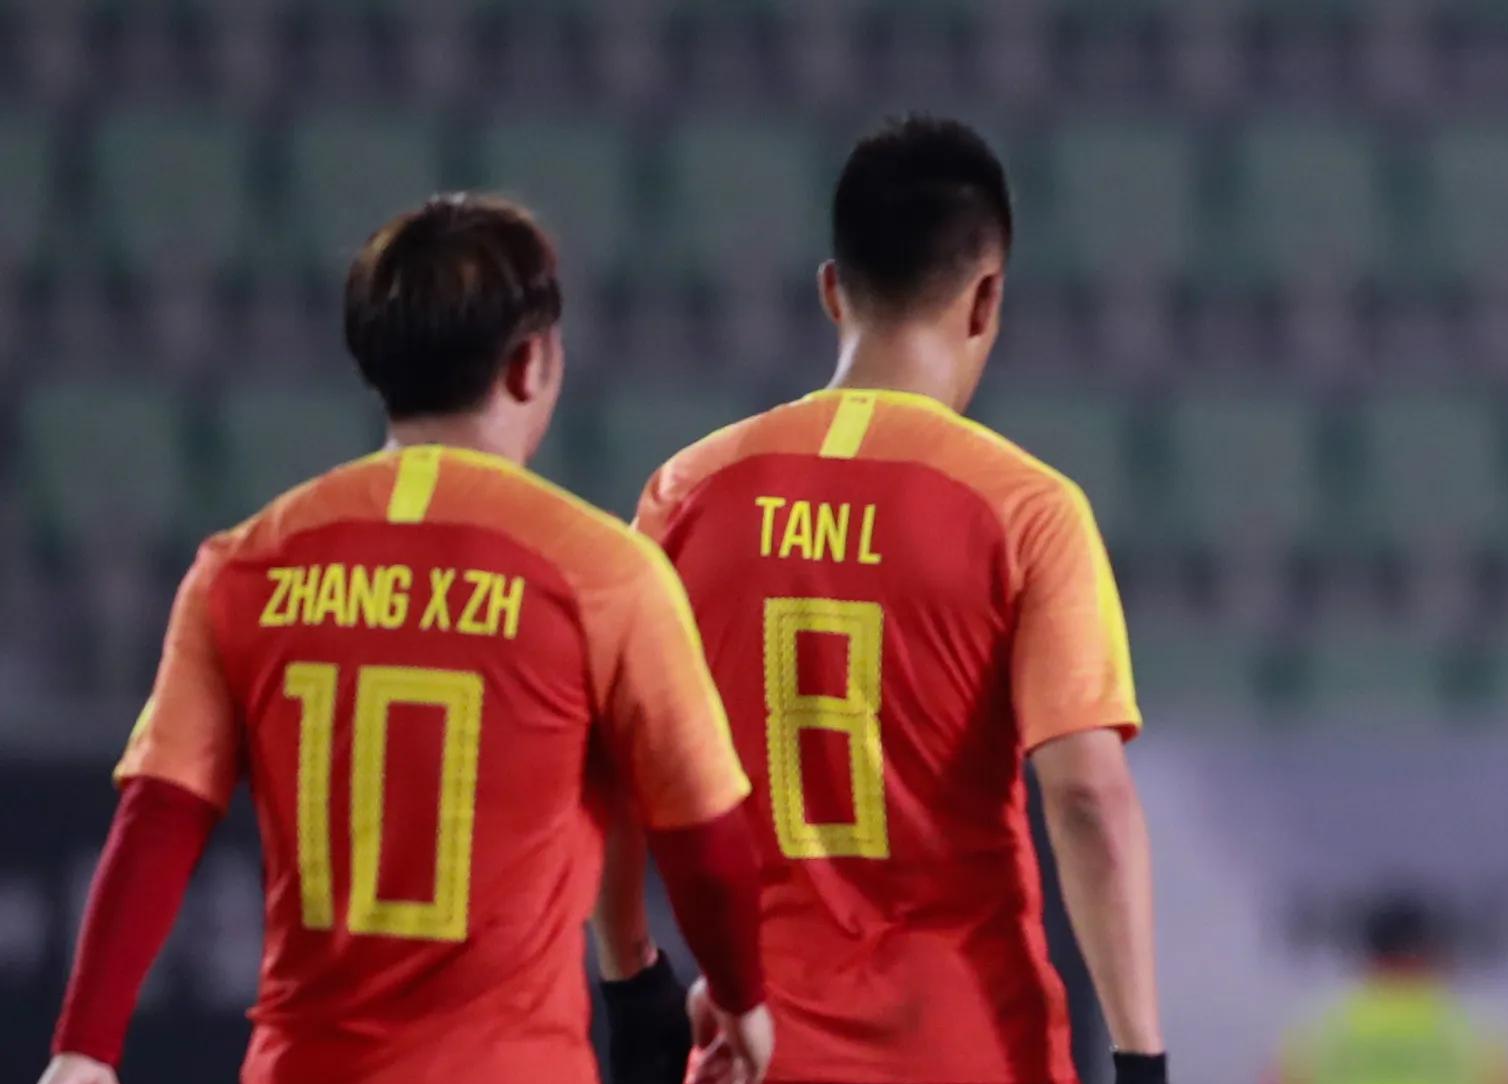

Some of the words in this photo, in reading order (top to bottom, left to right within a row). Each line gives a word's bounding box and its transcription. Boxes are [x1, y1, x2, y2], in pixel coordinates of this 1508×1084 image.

[259, 563, 413, 630] ZHANG
[419, 567, 456, 632] X
[456, 569, 525, 640] ZH
[755, 496, 850, 563] TAN
[858, 504, 882, 565] L
[283, 661, 485, 942] 10
[763, 597, 889, 860] 8
